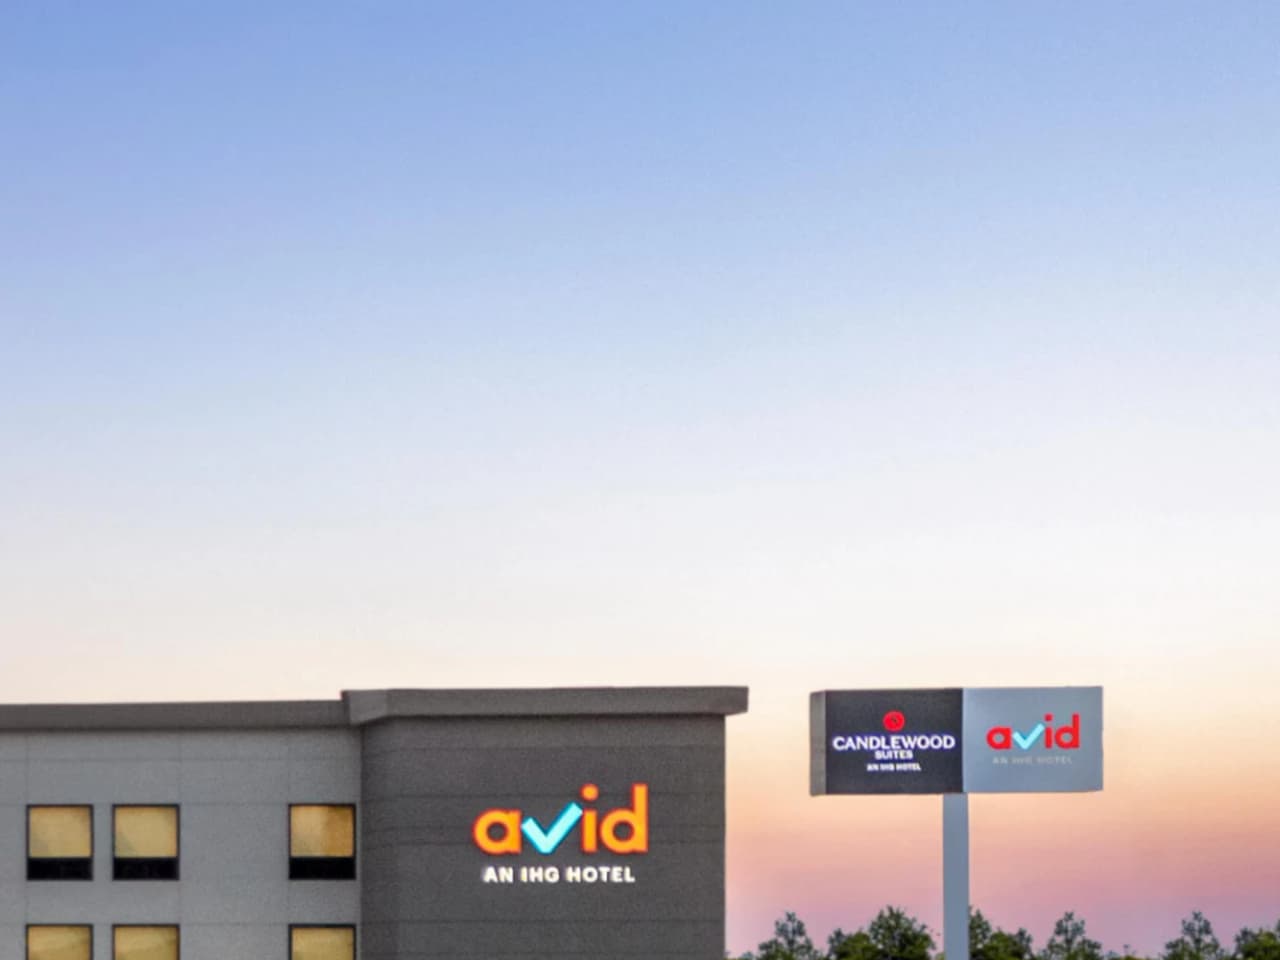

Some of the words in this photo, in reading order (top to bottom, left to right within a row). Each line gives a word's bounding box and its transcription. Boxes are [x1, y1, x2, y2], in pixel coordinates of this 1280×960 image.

[985, 713, 1081, 750] avid
[832, 735, 956, 750] CANDLEWOOD
[874, 750, 914, 760] SUITES
[472, 783, 649, 855] avid
[483, 866, 514, 883] AN
[521, 866, 560, 883] IHG
[566, 866, 636, 883] HOTEL
